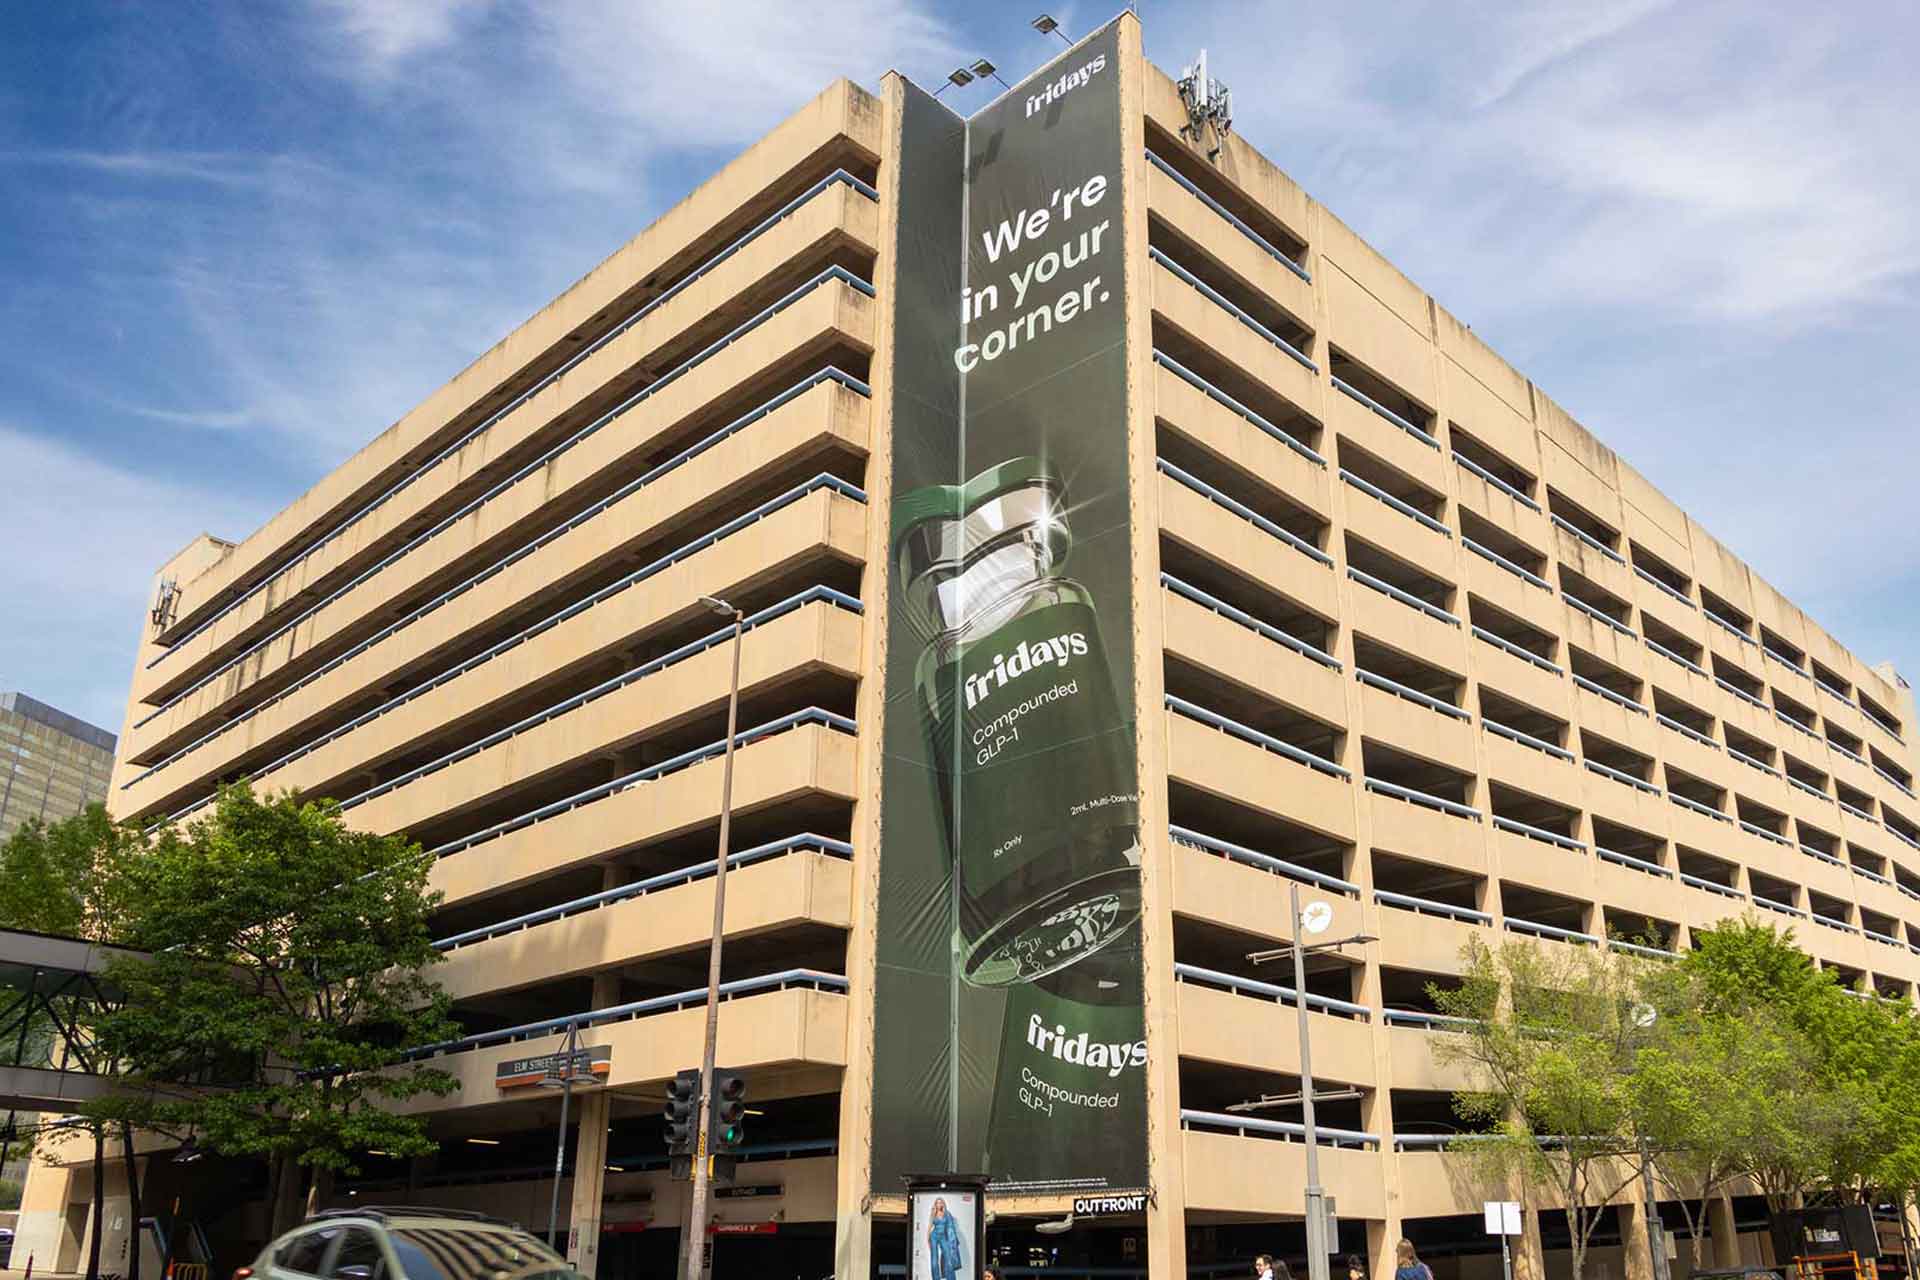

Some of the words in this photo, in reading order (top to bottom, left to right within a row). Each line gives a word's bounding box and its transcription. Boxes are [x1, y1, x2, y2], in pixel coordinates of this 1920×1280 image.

[1024, 53, 1106, 119] fridays
[982, 174, 1107, 263] We're
[961, 283, 998, 325] in
[1009, 220, 1111, 309] your
[954, 275, 1111, 375] corner.
[964, 631, 1089, 711] fridays
[973, 679, 1079, 746] Compounded
[976, 727, 1020, 767] GLP-1
[1026, 1013, 1148, 1077] fridays
[1018, 1088, 1054, 1118] GLP-1
[1021, 1066, 1119, 1109] Compounded
[1075, 1196, 1146, 1214] OUTFRONT
